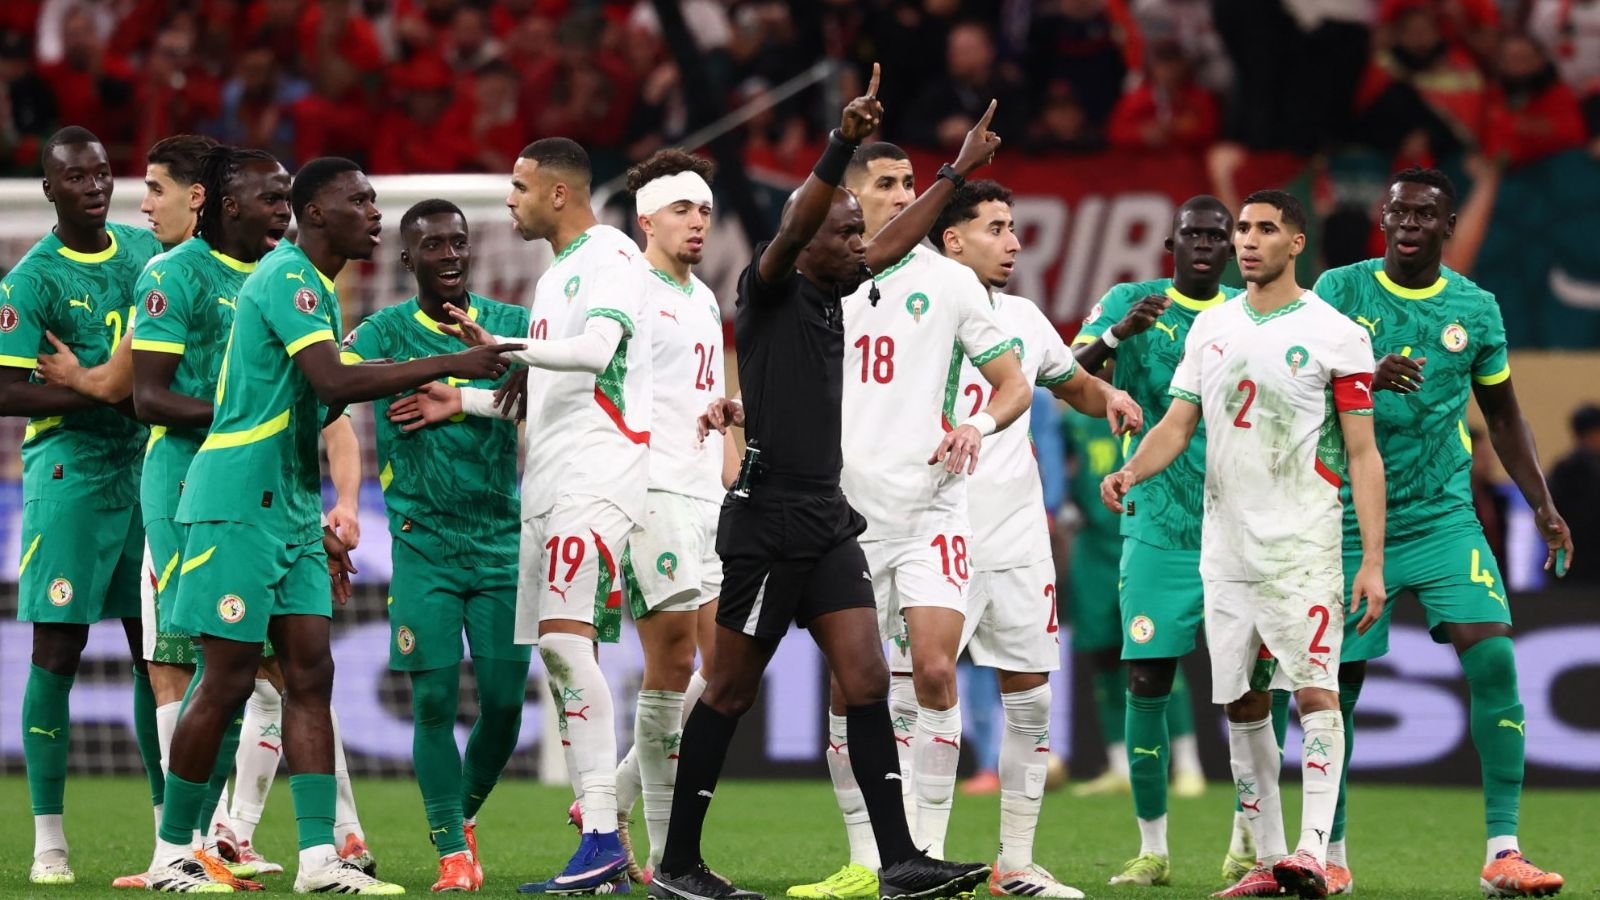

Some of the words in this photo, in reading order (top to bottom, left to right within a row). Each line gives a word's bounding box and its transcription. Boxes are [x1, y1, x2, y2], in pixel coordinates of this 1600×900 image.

[694, 343, 715, 392] 24
[854, 335, 895, 384] 18
[964, 383, 997, 417] 2
[1233, 379, 1257, 429] 2
[545, 535, 585, 583] 19
[930, 534, 969, 580] 18
[1470, 548, 1495, 588] 4
[1308, 605, 1331, 653] 2
